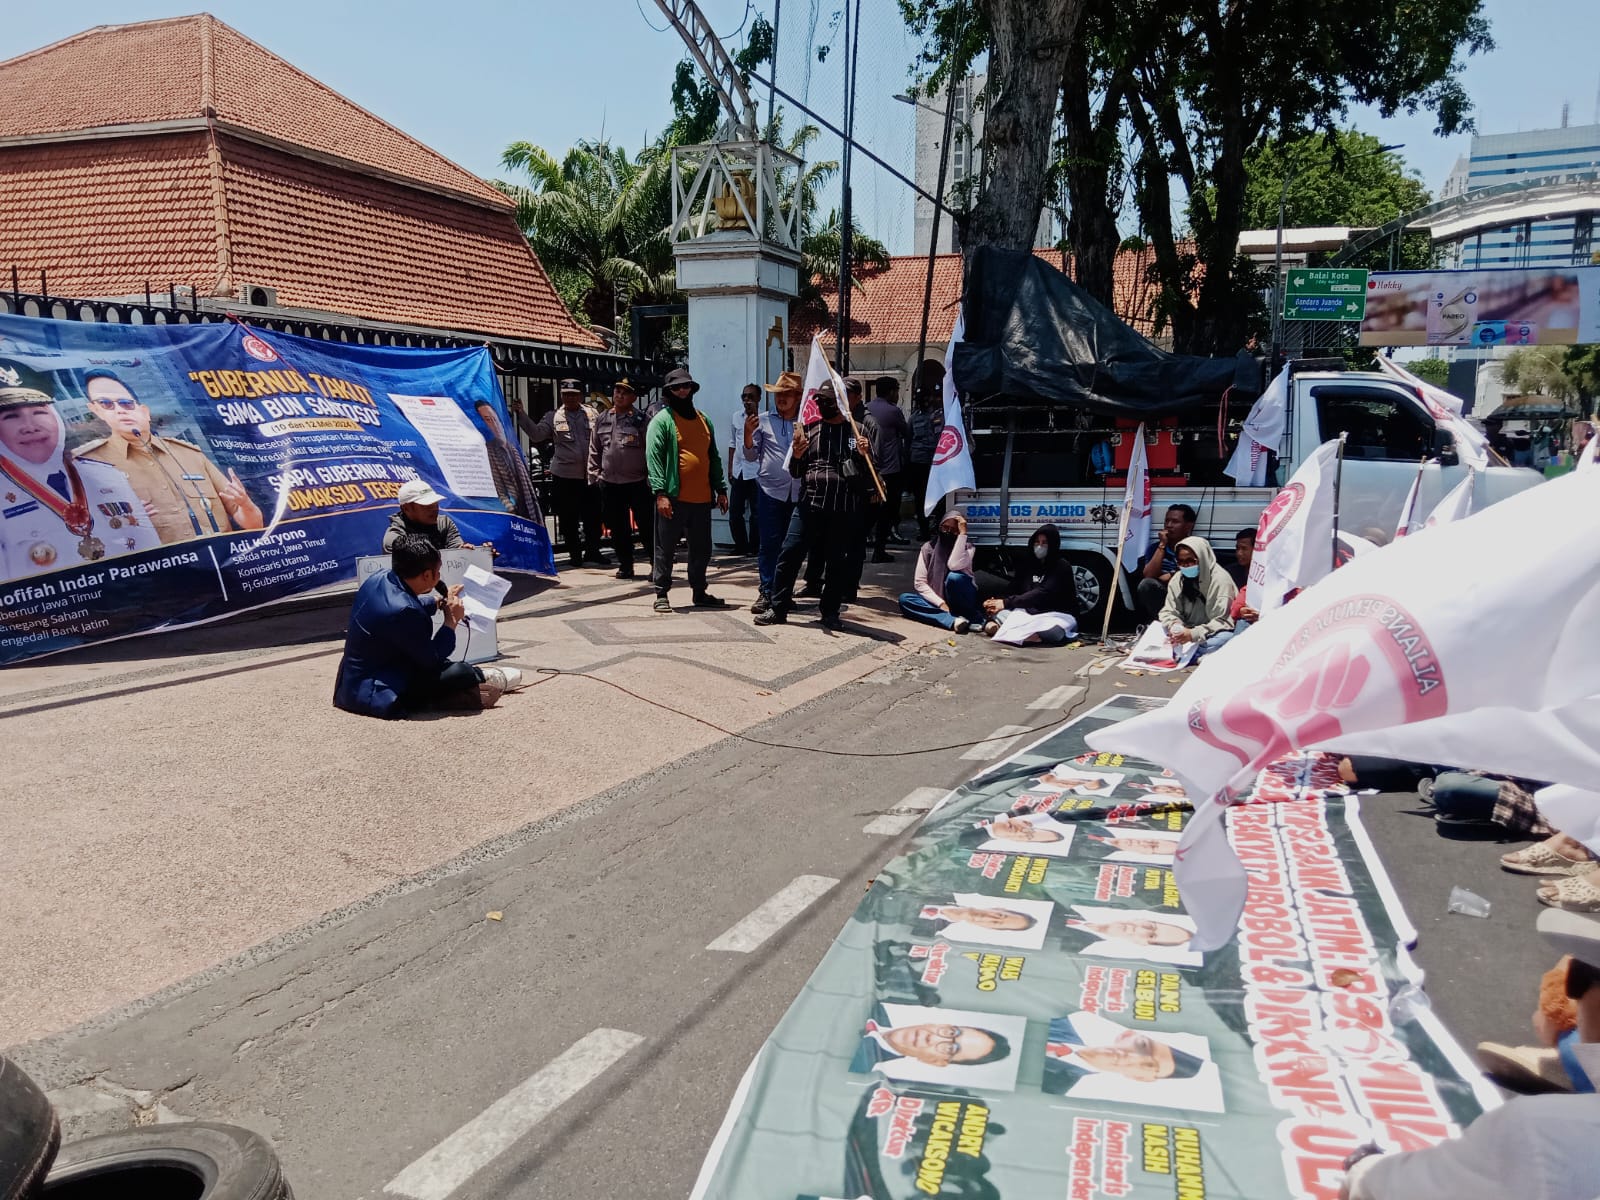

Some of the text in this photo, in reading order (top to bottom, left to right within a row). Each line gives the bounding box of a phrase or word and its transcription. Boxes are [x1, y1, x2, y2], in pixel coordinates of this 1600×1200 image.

[1309, 271, 1350, 280] Balai Kota
[216, 402, 266, 427] SAMA
[261, 396, 308, 419] BUN
[210, 438, 254, 450] Ungkapan
[254, 437, 293, 450] tersebut
[234, 452, 260, 462] kasus
[259, 451, 286, 462] kredit
[308, 444, 331, 454] Bank
[316, 463, 391, 484] GUBERNUR
[389, 465, 420, 482] YANG
[287, 484, 367, 511] DIMAKSUD
[966, 505, 1086, 517] SANOS AUDIO
[261, 548, 284, 560] Prov.
[284, 543, 303, 555] Jawa
[303, 537, 326, 549] Timur
[60, 571, 105, 592] Indar
[109, 551, 200, 581] Parawansa
[237, 554, 310, 578] Komisaris Utama
[296, 560, 339, 577] 2024-2025
[0, 588, 103, 620] bernur Jawa Timur
[0, 607, 89, 633] emegang Saham
[1, 617, 110, 648] engedali Bank Jatim
[1292, 843, 1345, 892] BANK
[1302, 893, 1368, 961] JATIM:
[883, 1098, 923, 1158] Direktur
[956, 1102, 990, 1158] ANDRY
[915, 1101, 962, 1195] WICAKSONO
[1104, 1121, 1131, 1194] Komisaris
[1143, 1123, 1171, 1175] NASIH
